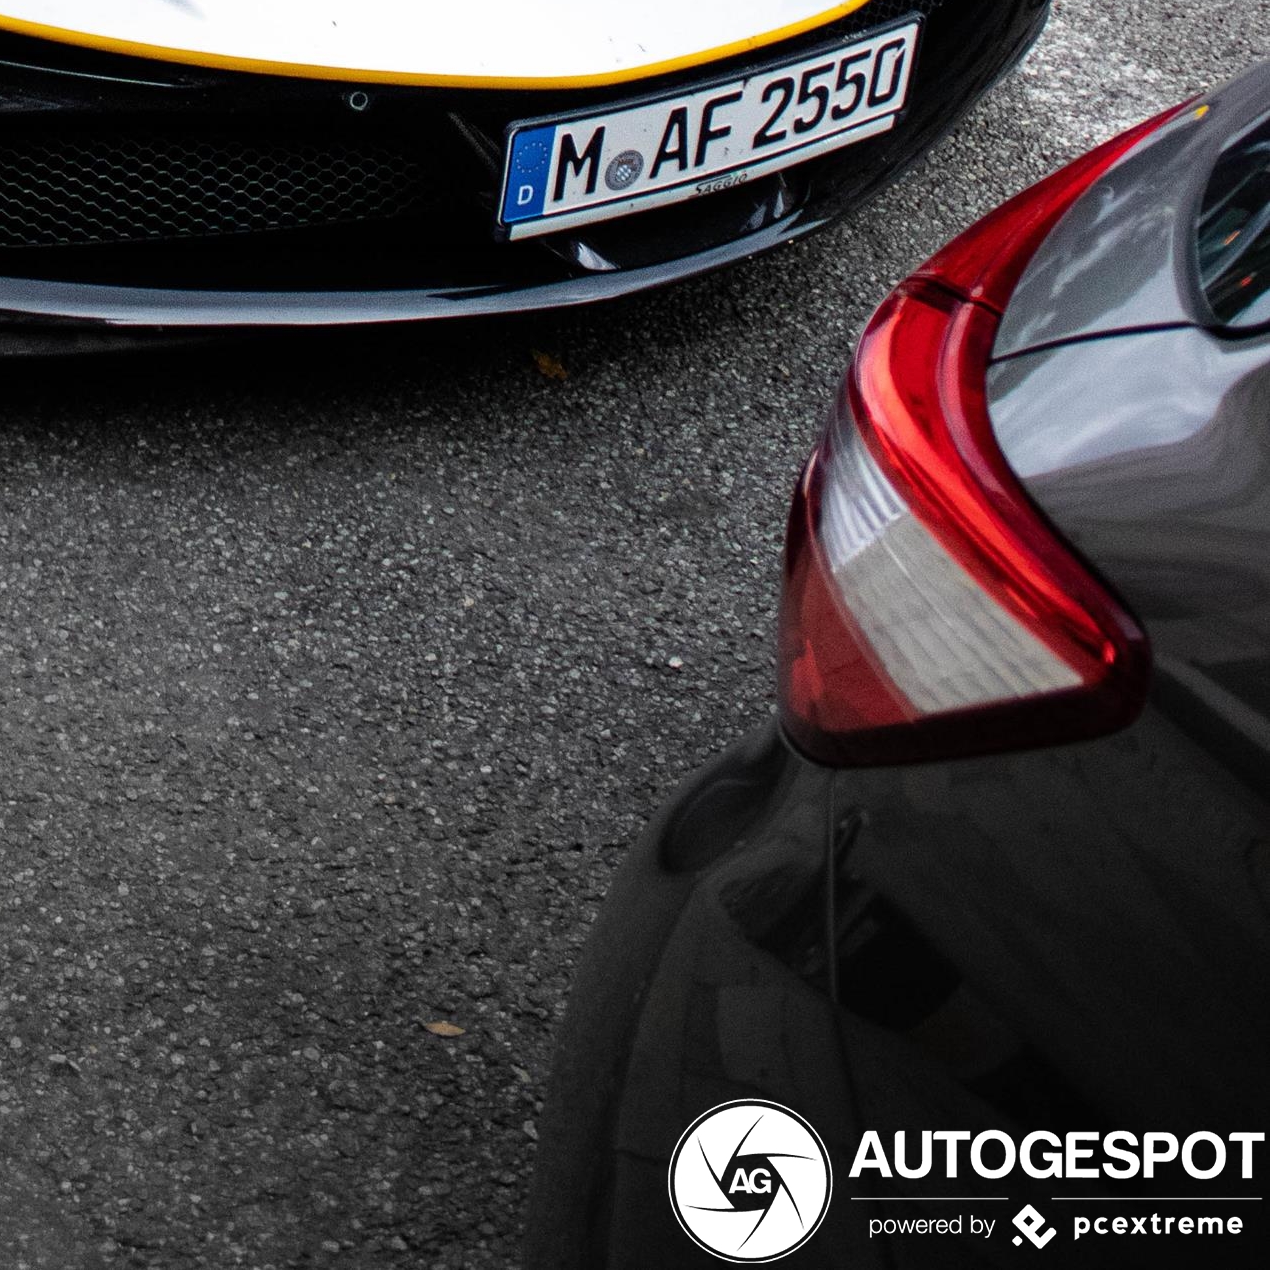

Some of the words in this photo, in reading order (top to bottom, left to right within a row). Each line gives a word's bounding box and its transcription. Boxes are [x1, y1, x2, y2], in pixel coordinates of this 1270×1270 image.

[517, 185, 534, 206] D
[553, 126, 606, 202] M
[649, 90, 743, 180] AF
[752, 37, 906, 150] 2550
